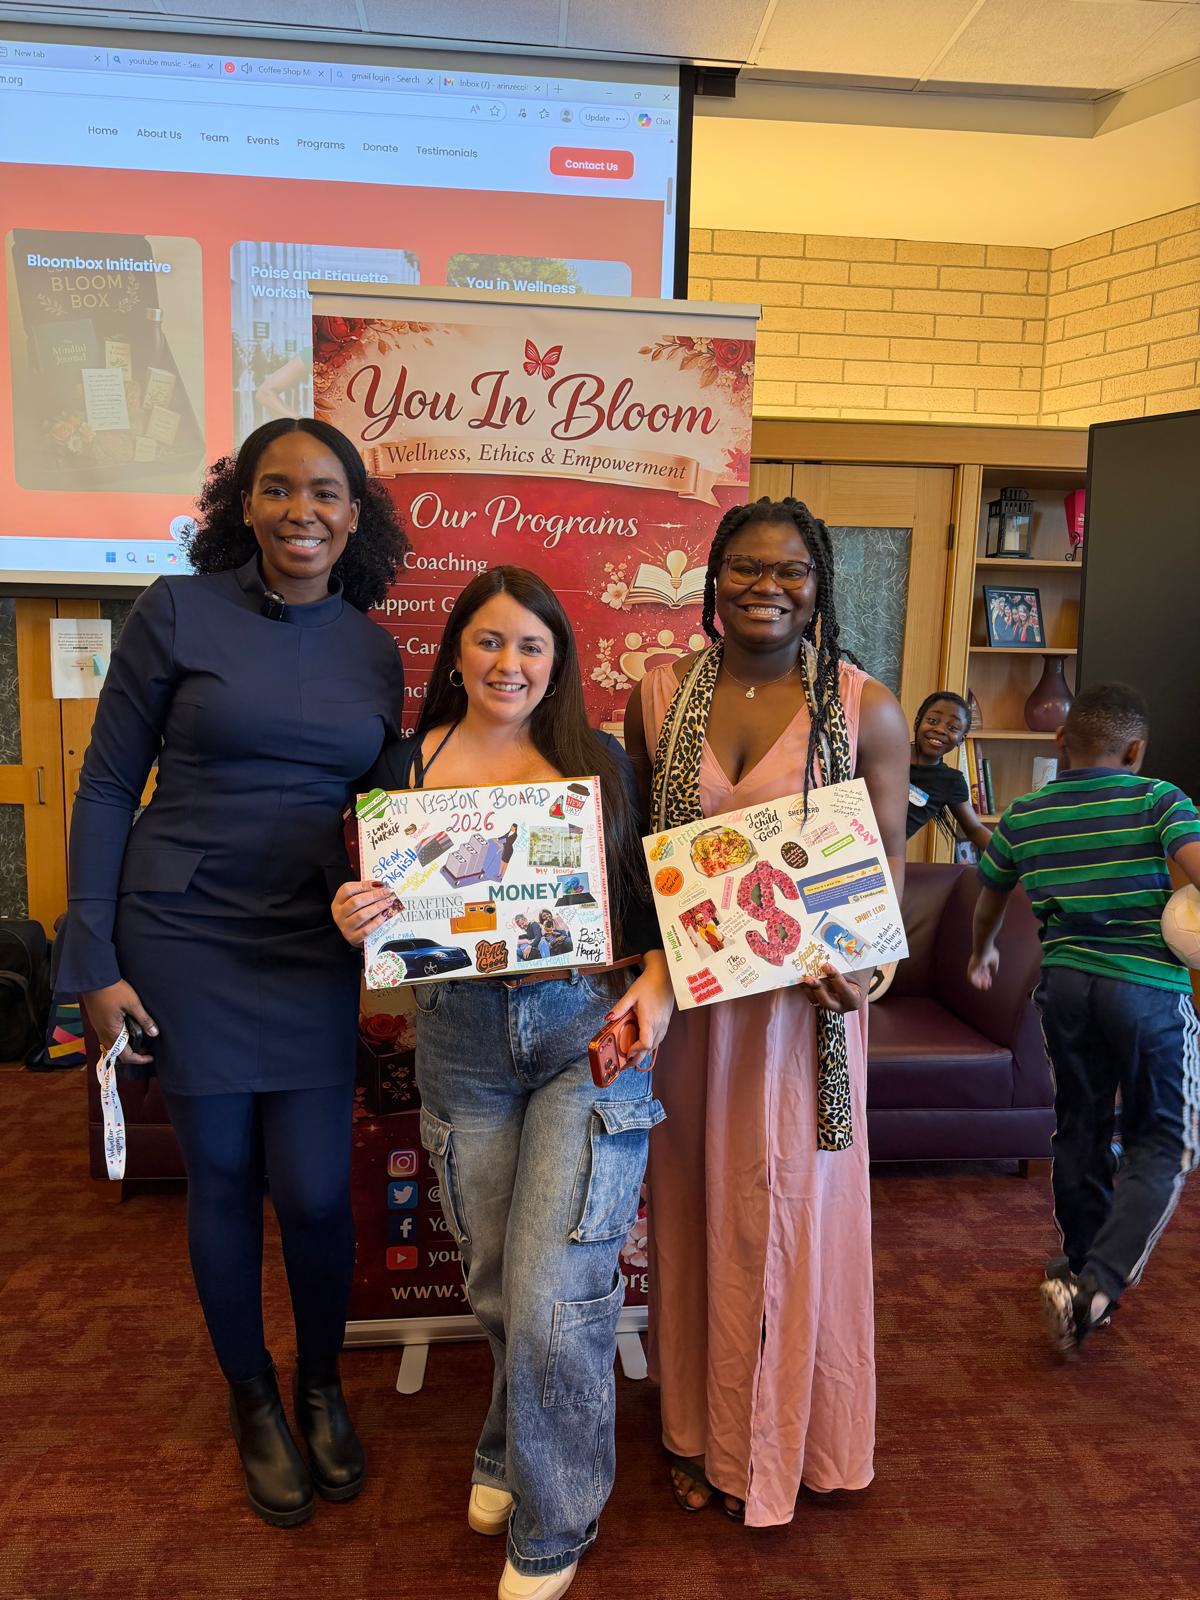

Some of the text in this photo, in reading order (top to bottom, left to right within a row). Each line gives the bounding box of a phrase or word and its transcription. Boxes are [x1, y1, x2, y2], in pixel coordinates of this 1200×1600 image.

[14, 48, 45, 58] New tab
[129, 57, 158, 66] youtube
[160, 59, 181, 67] music
[258, 65, 281, 75] Coffee
[283, 68, 300, 77] Shop
[352, 73, 371, 82] gmail
[372, 74, 390, 83] login
[397, 75, 419, 84] Search
[460, 79, 479, 88] Inbox
[585, 113, 671, 126] Update Chat
[88, 125, 478, 158] Home About Us Team Events Programs Donate Testimonials
[565, 159, 619, 171] Contact Us
[27, 254, 103, 271] Bloombox
[106, 257, 172, 273] Initiative
[51, 274, 123, 292] BLOOM
[251, 265, 389, 283] Poise and Etiquette
[467, 276, 577, 295] You in Wellness
[71, 293, 110, 309] BOX
[345, 363, 721, 442] You In Bloom
[385, 441, 688, 480] Wellness, Ethics & Empowerment
[409, 491, 640, 549] Our Programs
[402, 551, 489, 575] Coaching
[368, 597, 436, 617] upport
[391, 787, 551, 815] MY VISION BOARD
[754, 810, 779, 829] child
[788, 806, 820, 817] SHEPERD
[446, 811, 495, 832] 2026
[849, 818, 878, 846] PRAY
[372, 848, 404, 878] SPEAK
[489, 882, 561, 901] MONEY
[400, 908, 465, 923] MEMORIES
[854, 904, 886, 924] SPIRIT LEAD
[578, 928, 594, 944] Be
[877, 927, 901, 954] All Things
[878, 923, 893, 940] Makes
[576, 943, 604, 962] Happy
[890, 939, 902, 952] New
[726, 954, 740, 966] The
[728, 957, 747, 974] LORD
[805, 953, 824, 972] hope
